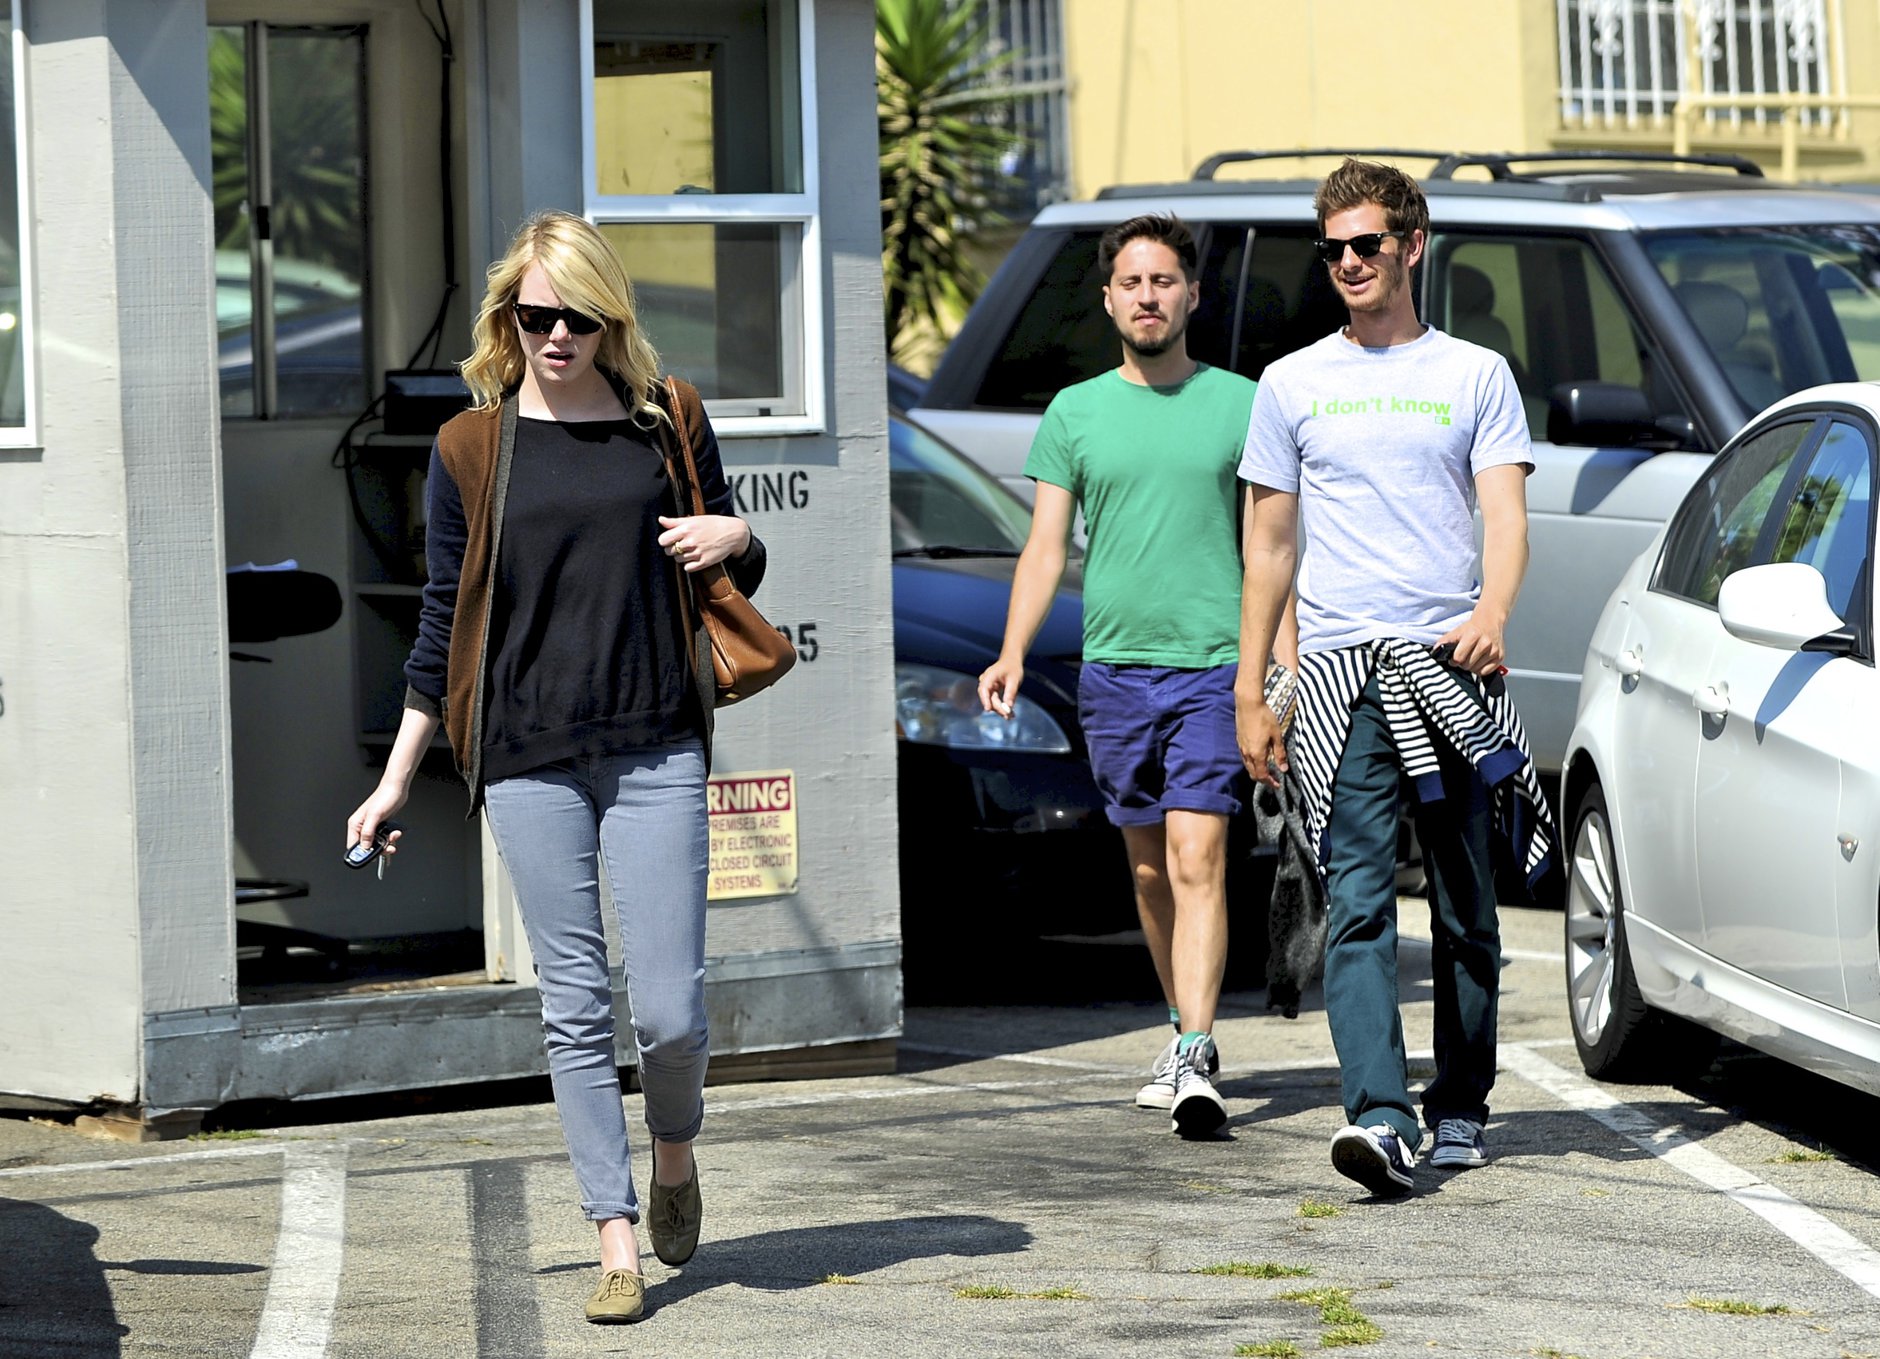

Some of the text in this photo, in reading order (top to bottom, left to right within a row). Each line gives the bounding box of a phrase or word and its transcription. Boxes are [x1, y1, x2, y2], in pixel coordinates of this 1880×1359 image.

[1311, 396, 1451, 417] I don't know
[727, 471, 809, 512] KING
[707, 780, 789, 812] RNING
[709, 815, 780, 832] REMISES ARE
[711, 833, 792, 852] BY ELECTRONIC
[710, 852, 792, 871] CLOSED CIRCUIT
[715, 875, 762, 890] SYSTEMS
